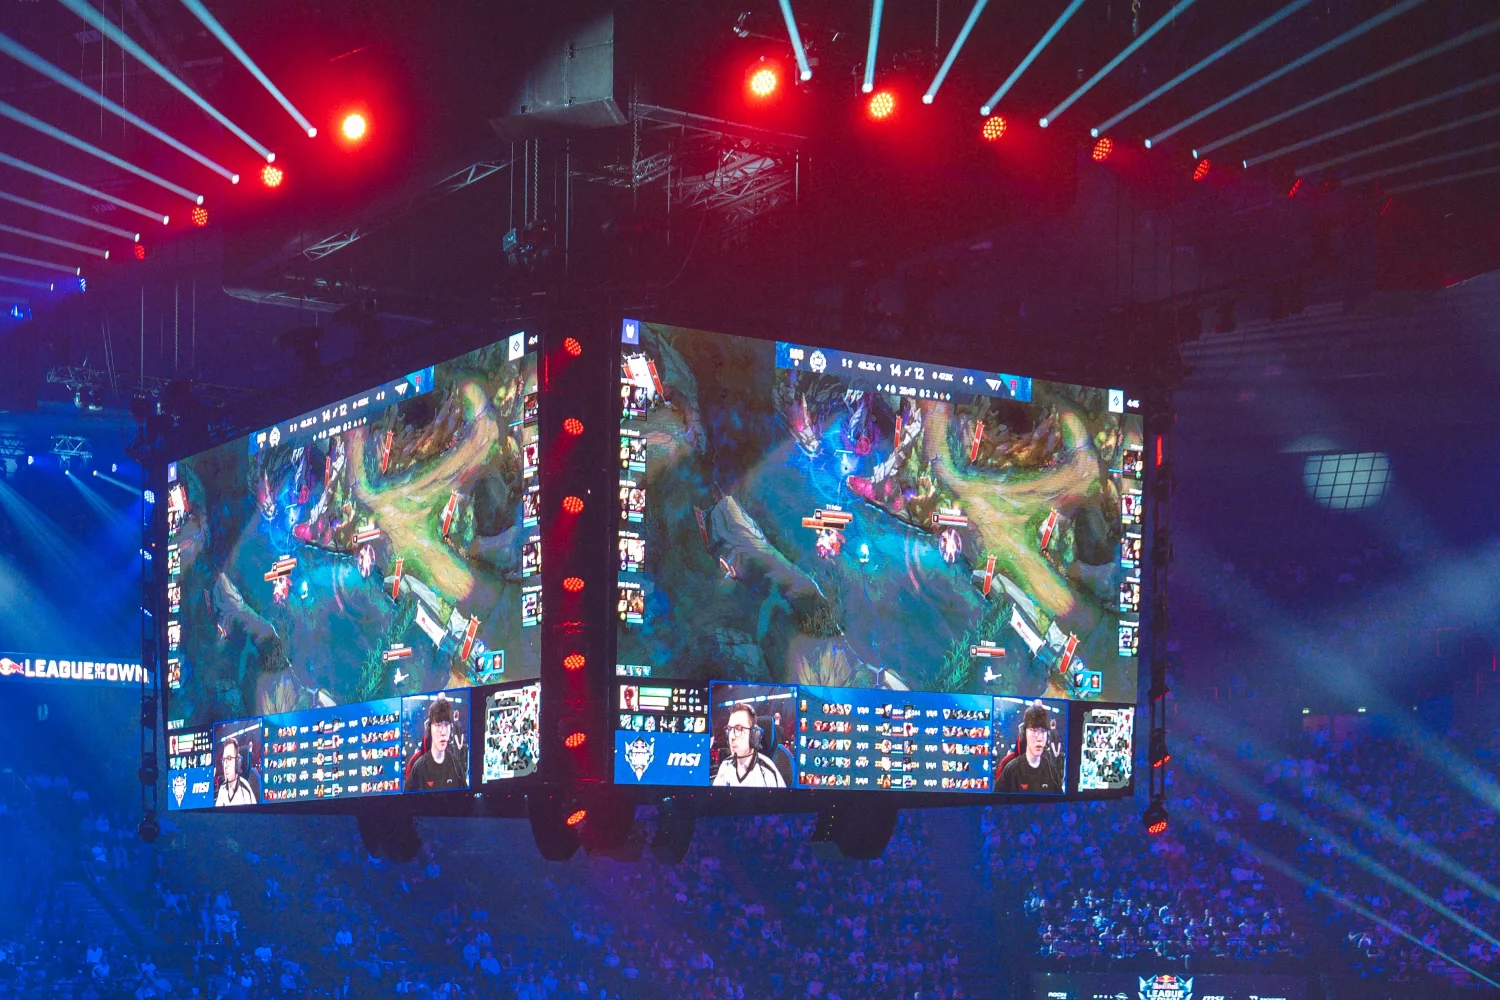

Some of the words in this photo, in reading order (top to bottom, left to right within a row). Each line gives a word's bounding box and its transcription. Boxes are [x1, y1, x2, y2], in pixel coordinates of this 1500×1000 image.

[890, 364, 901, 377] 14
[914, 367, 924, 380] 12
[25, 658, 94, 680] LEAGUE
[106, 662, 150, 684] OWN
[1146, 989, 1185, 998] LEAGUE
